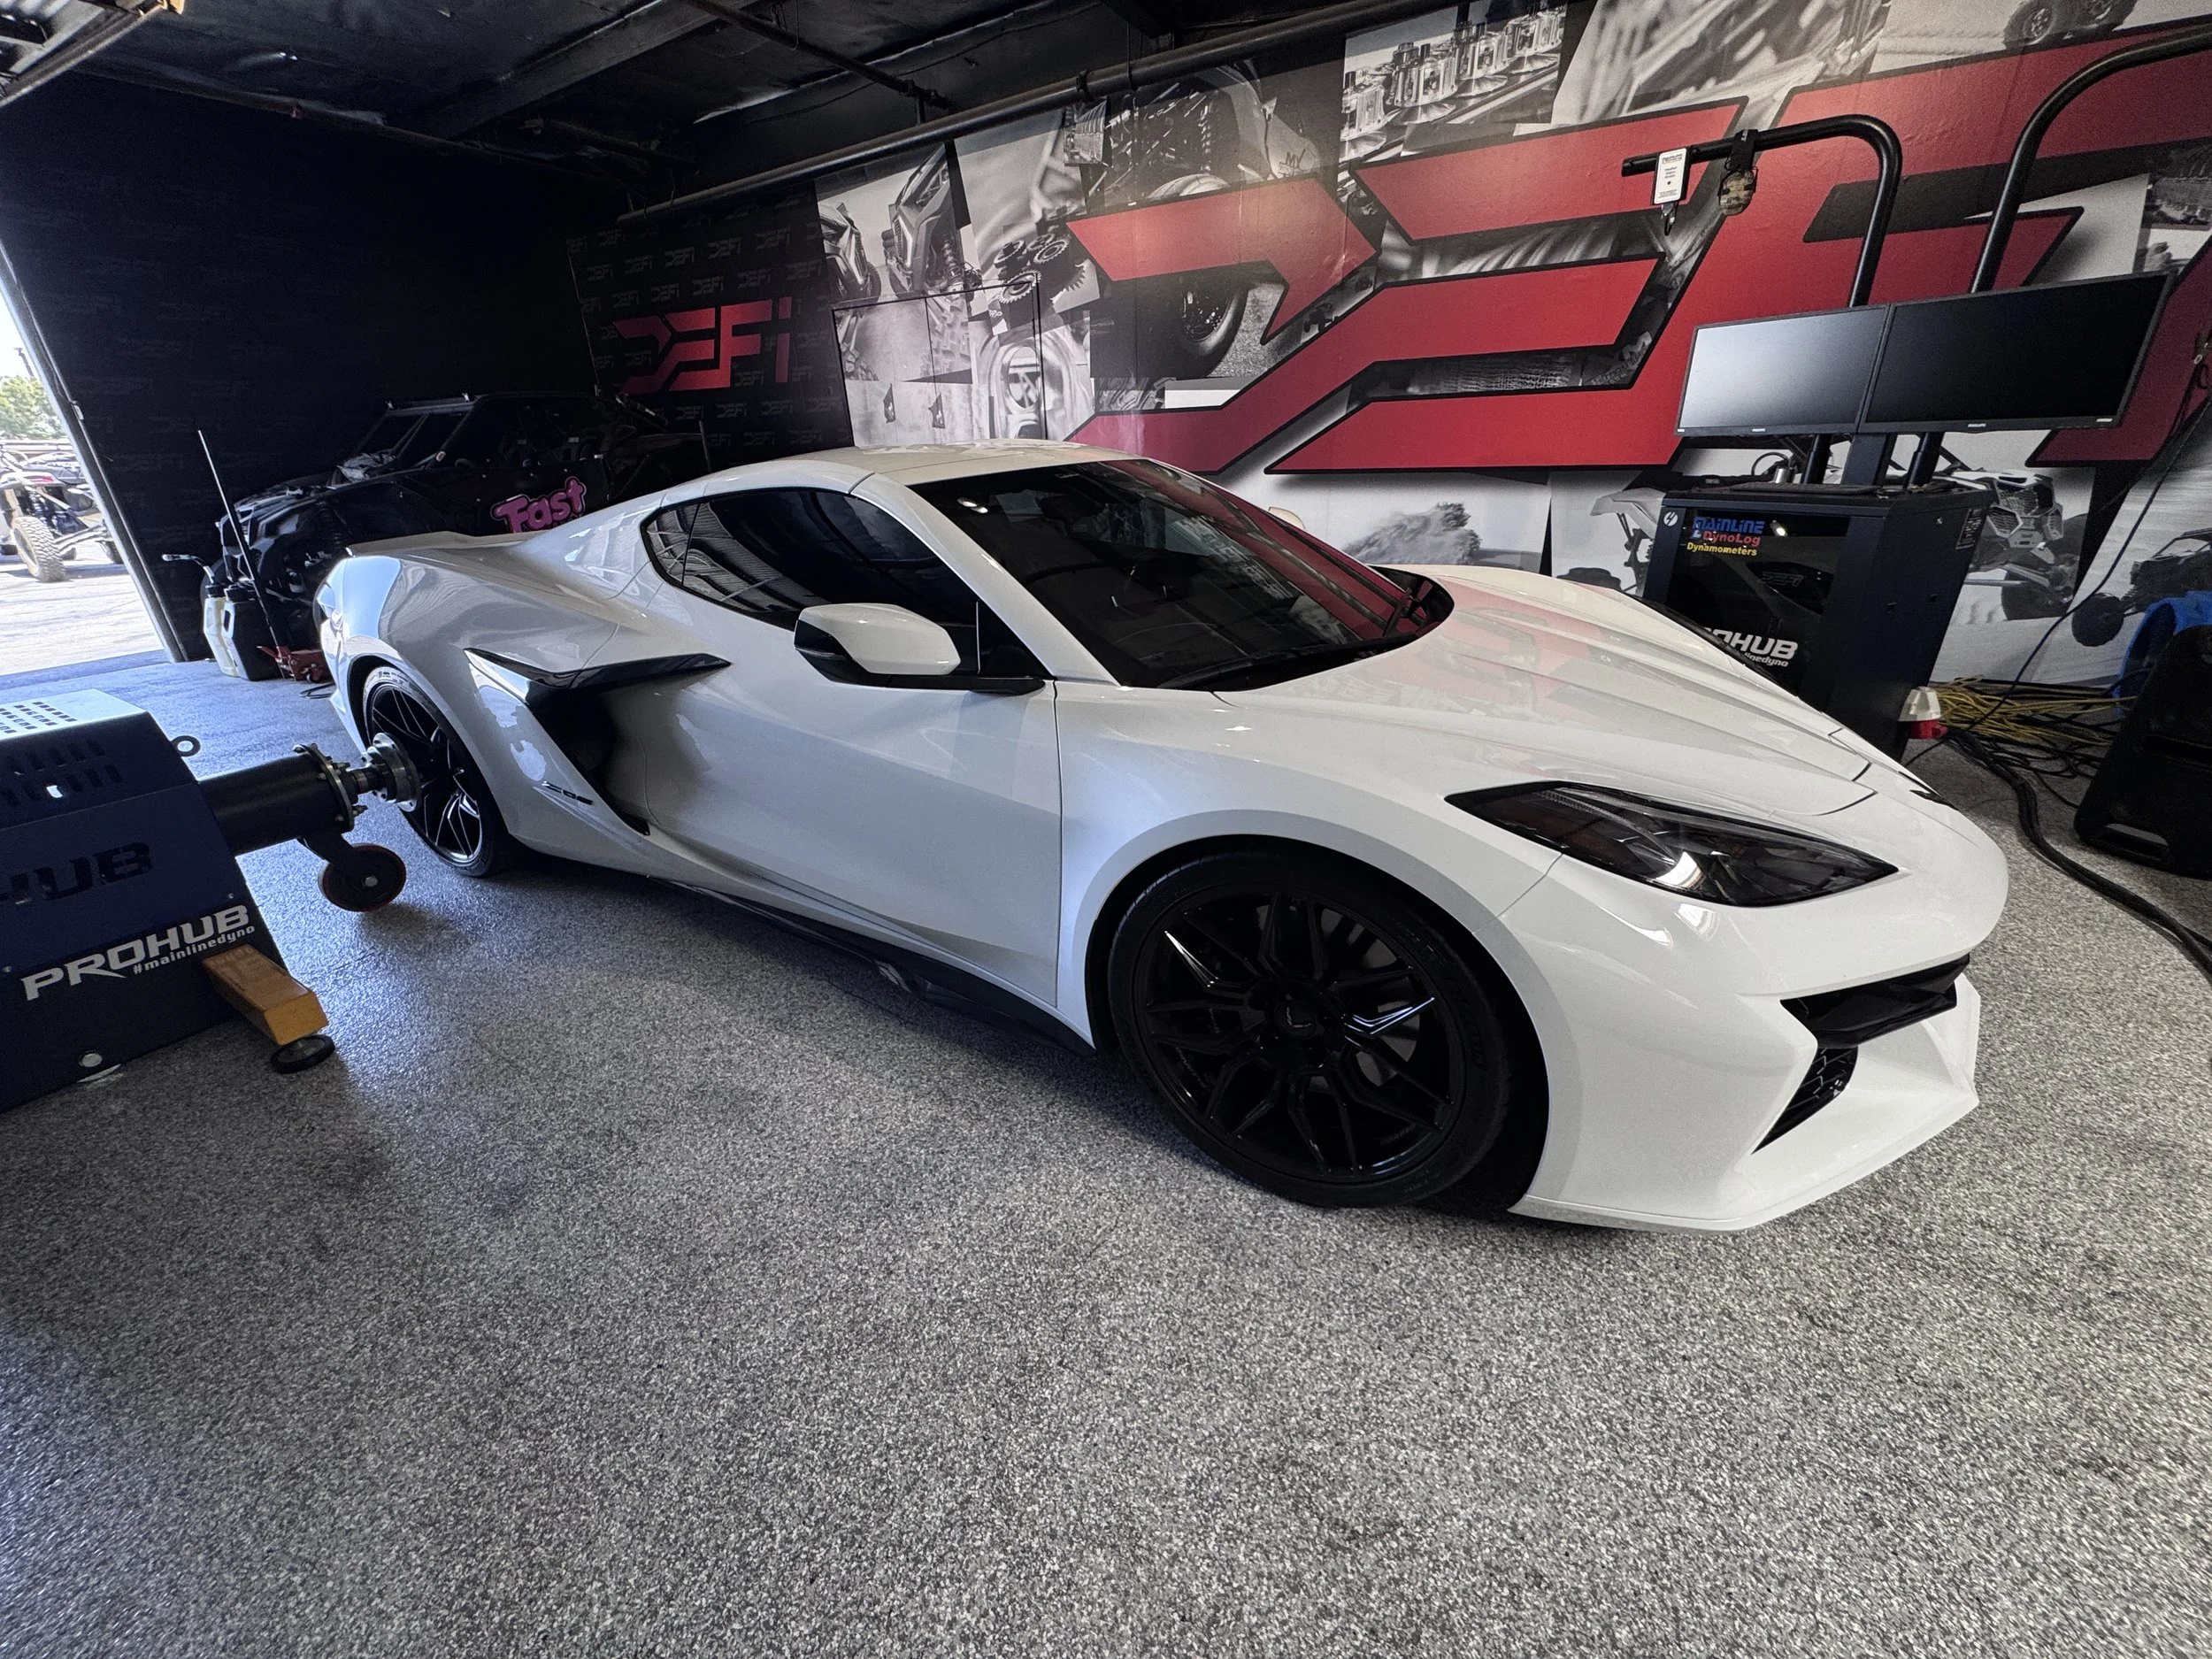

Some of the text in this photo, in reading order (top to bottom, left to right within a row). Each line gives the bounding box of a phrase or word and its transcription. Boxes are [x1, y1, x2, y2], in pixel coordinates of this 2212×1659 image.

[491, 476, 587, 534] Fast
[1686, 541, 1757, 557] Dynamometers
[1702, 531, 1761, 548] DynoLog
[20, 904, 250, 1002] PROHUB
[133, 925, 256, 975] #mainlinedyno
